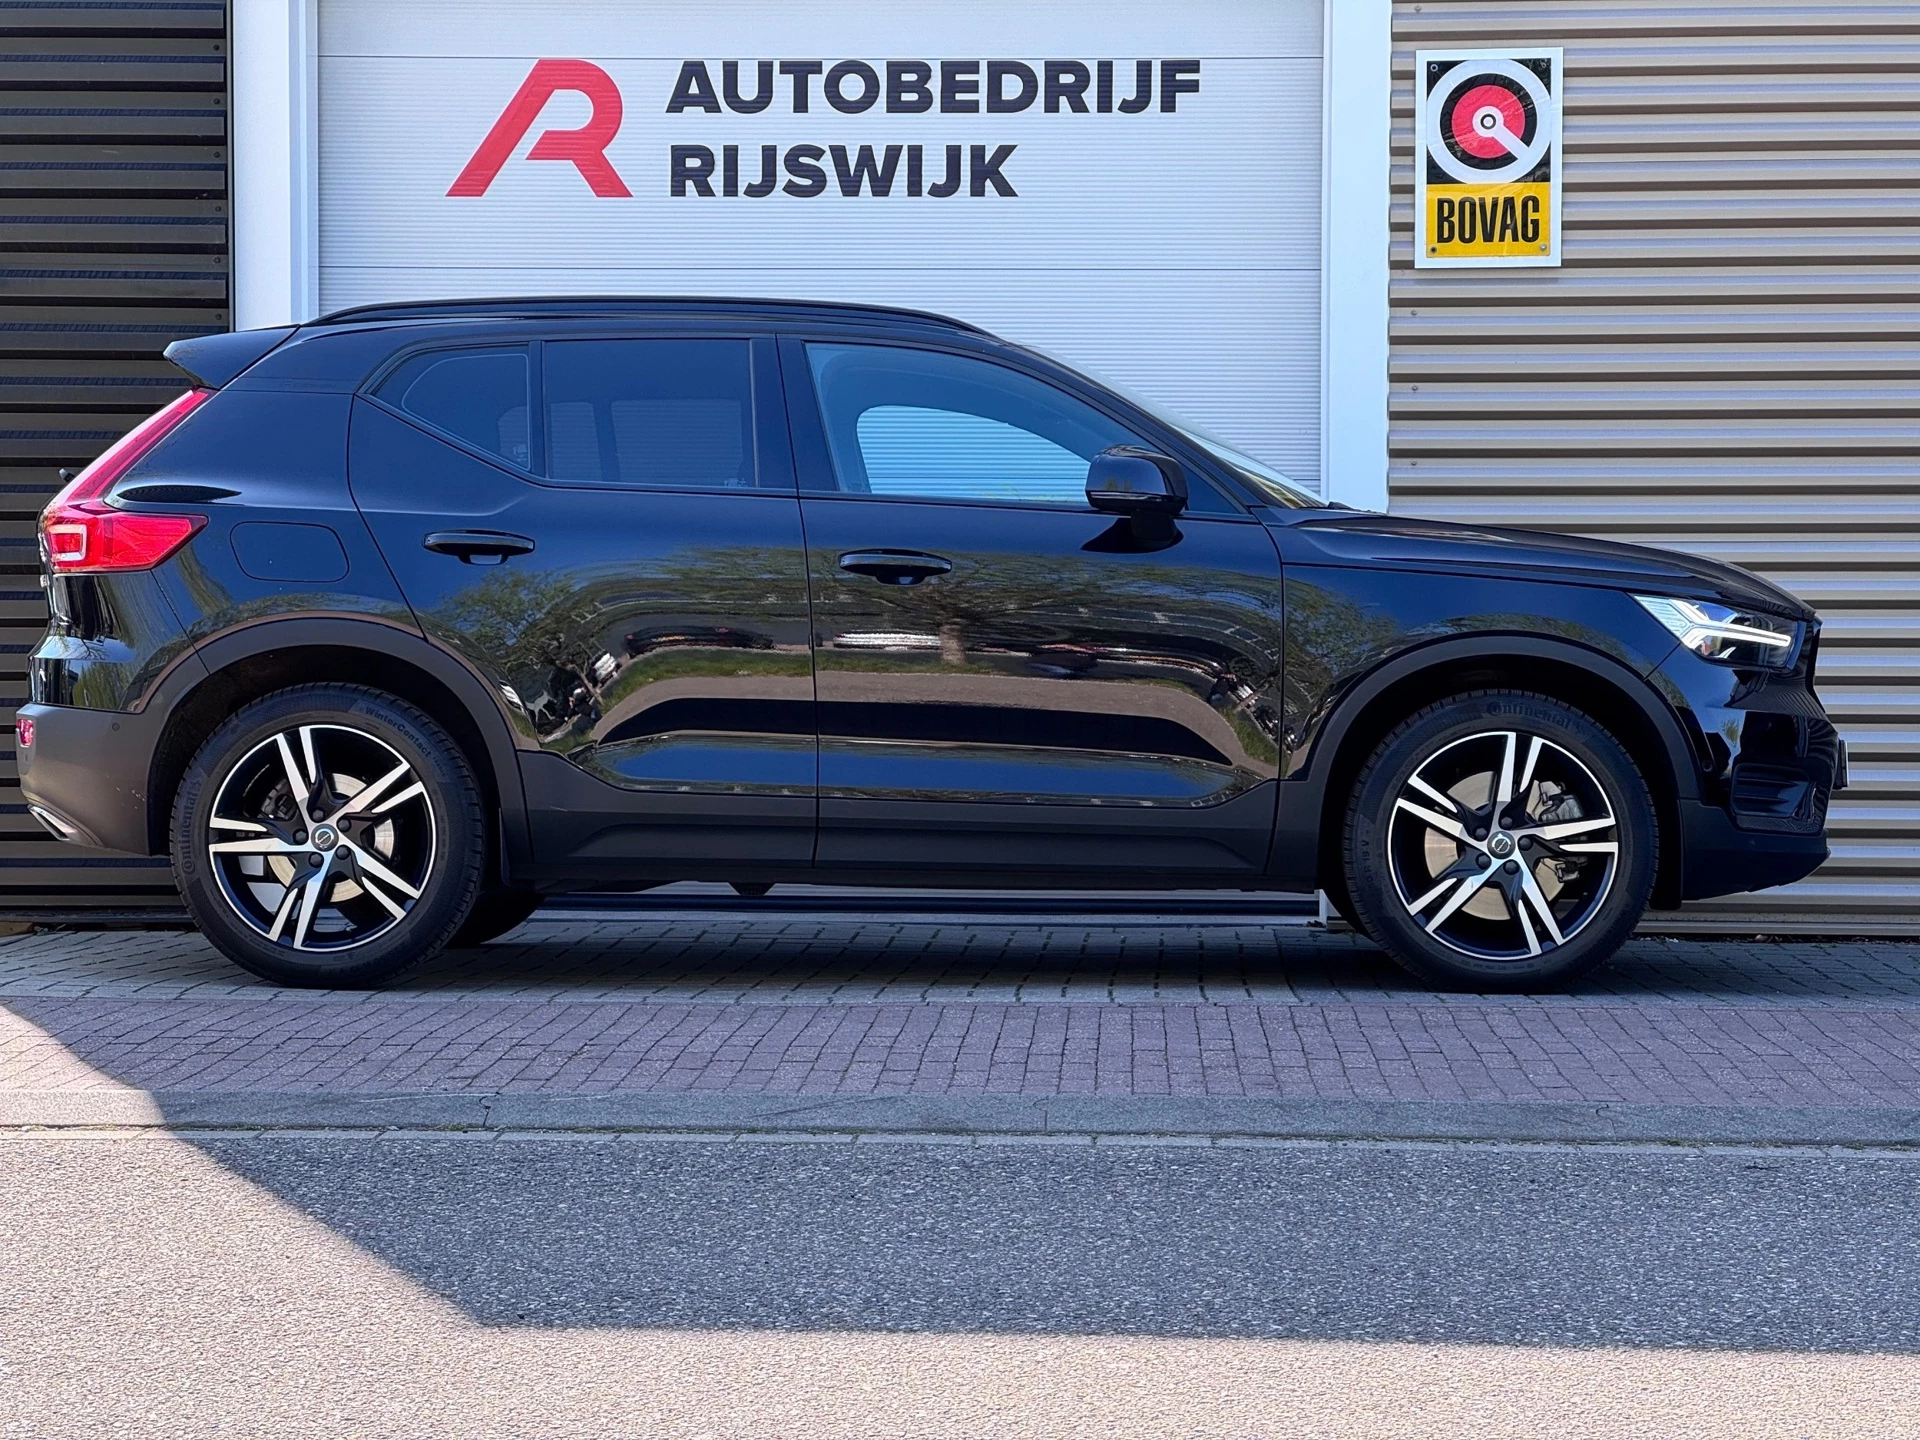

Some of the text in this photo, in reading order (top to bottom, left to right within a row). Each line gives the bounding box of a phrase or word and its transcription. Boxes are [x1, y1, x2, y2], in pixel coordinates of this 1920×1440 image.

[665, 59, 1201, 114] AUTOBEDRIJF
[670, 143, 1019, 197] RIJSWIJK
[1436, 195, 1540, 244] BOVAG
[365, 706, 432, 758] WinterContact
[1487, 701, 1571, 729] Continental
[179, 790, 198, 875] Continental
